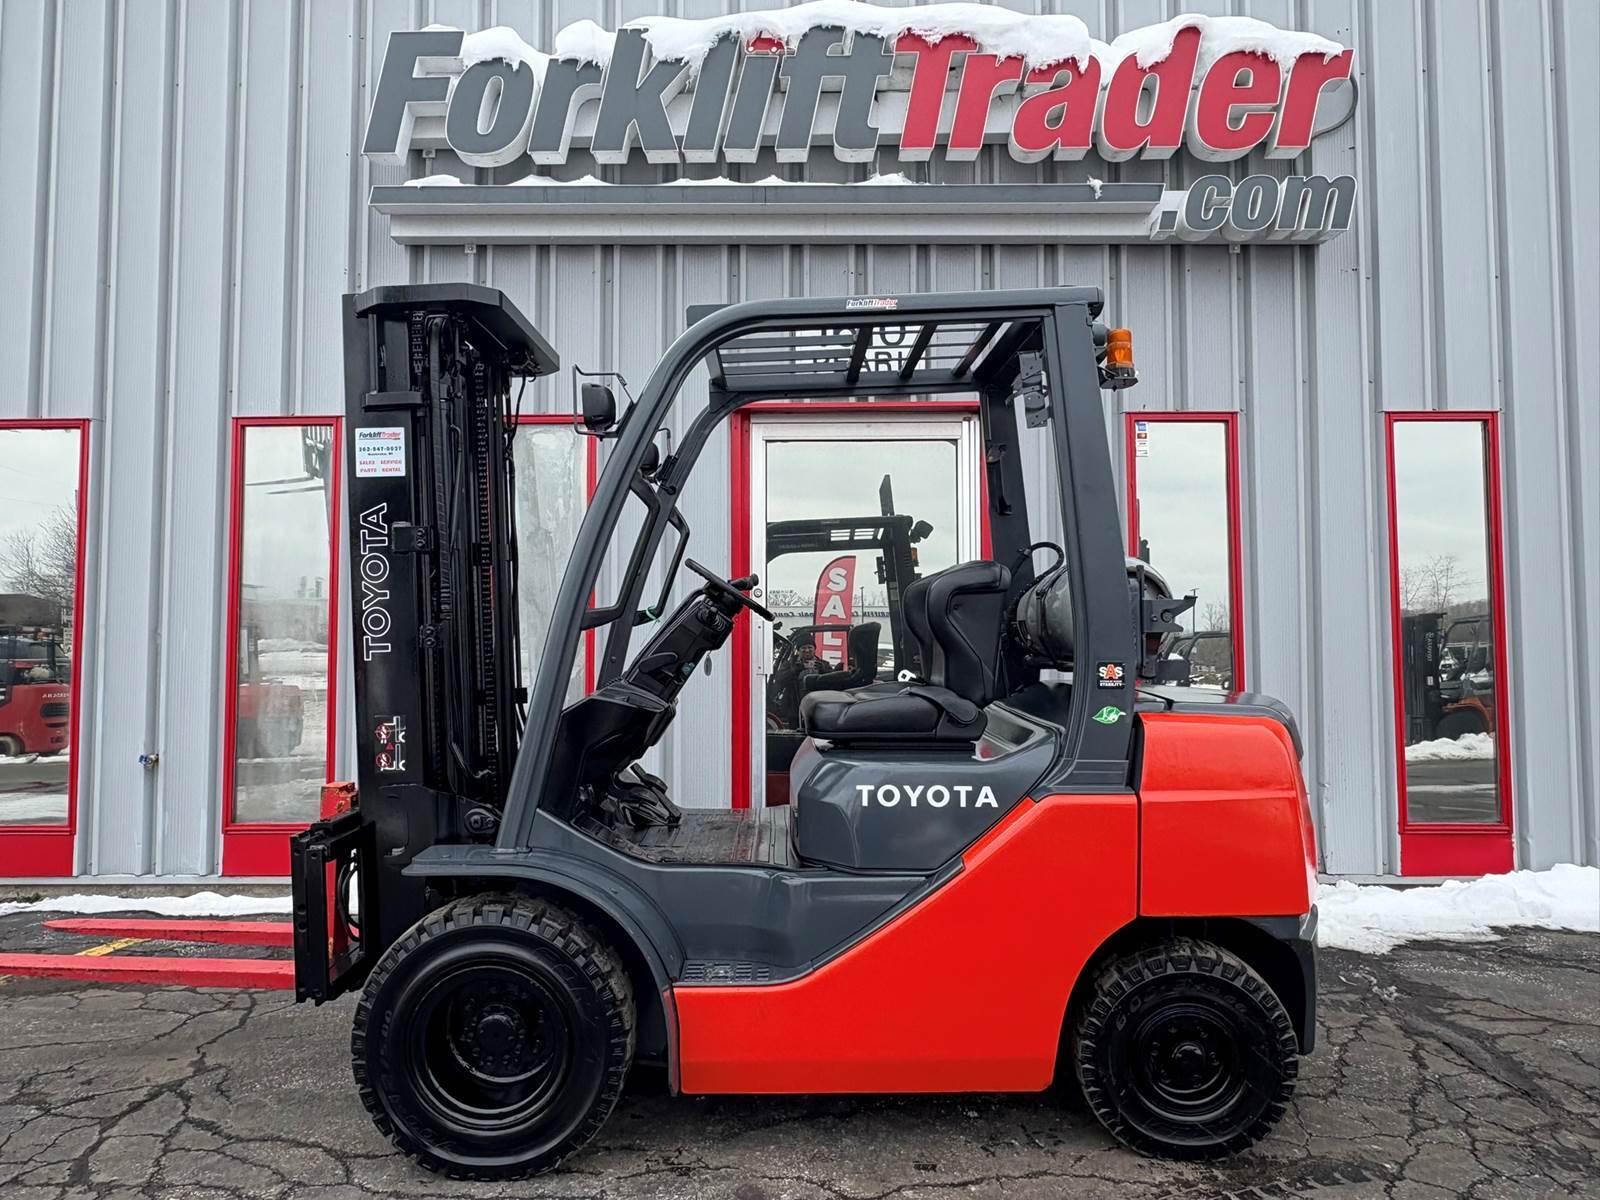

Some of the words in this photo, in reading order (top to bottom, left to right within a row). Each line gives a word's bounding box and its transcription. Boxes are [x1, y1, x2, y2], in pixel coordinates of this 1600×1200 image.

[1158, 174, 1357, 232] .com
[360, 502, 391, 661] TOYOTA
[1099, 664, 1123, 679] SAS
[855, 785, 999, 808] TOYOTA
